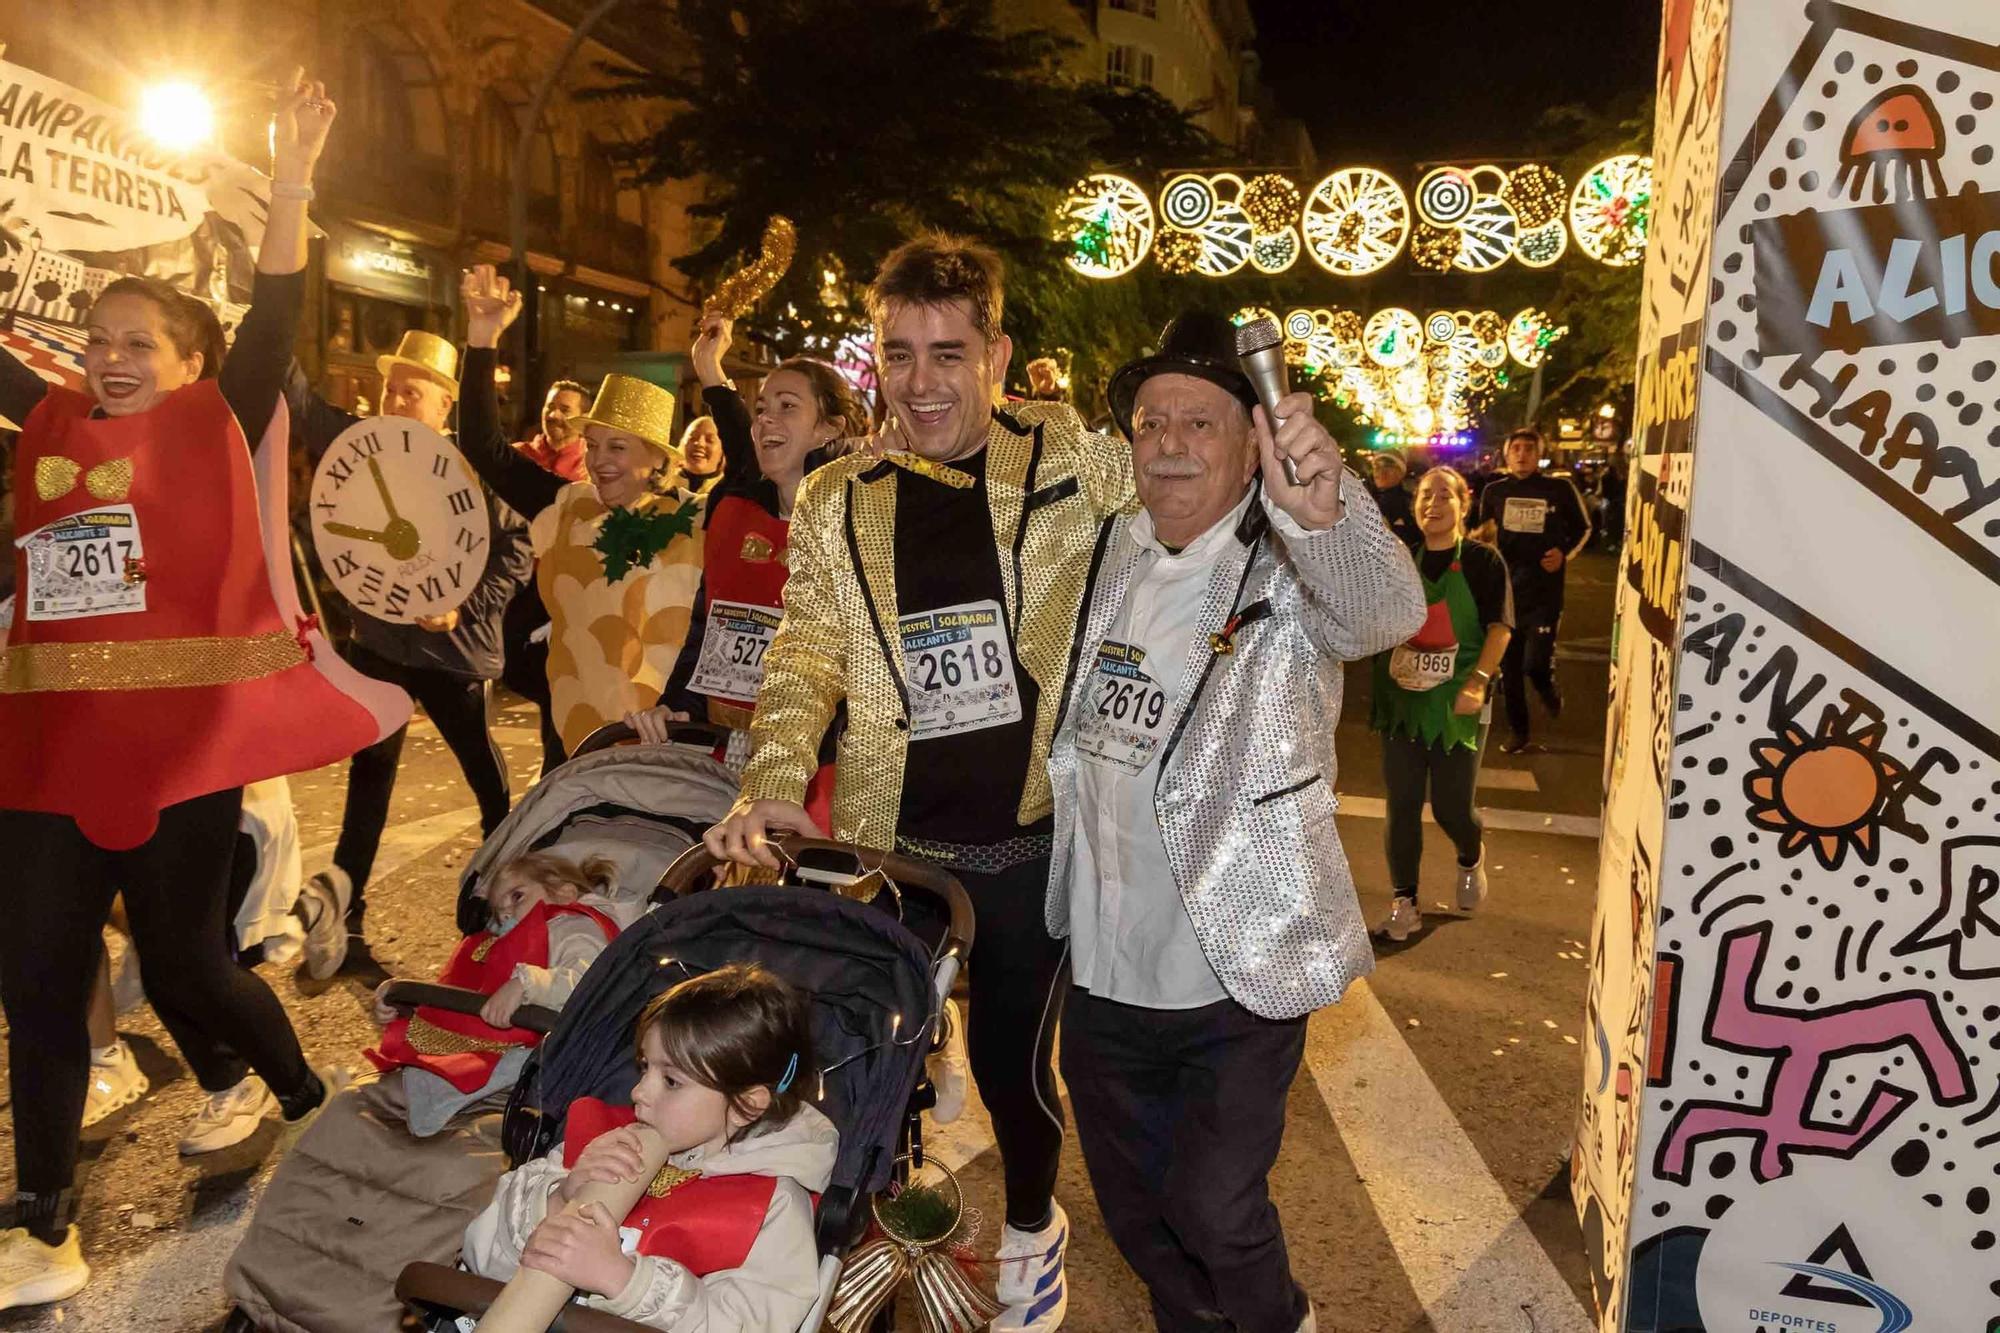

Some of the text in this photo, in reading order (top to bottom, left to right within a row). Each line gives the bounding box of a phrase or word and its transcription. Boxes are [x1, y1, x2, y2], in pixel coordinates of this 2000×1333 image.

[46, 148, 187, 222] TERRETA
[348, 432, 384, 464] XII
[326, 456, 354, 490] XI
[432, 454, 449, 480] II
[317, 493, 337, 518] X
[447, 488, 475, 515] III
[455, 527, 485, 554] IV
[66, 540, 133, 578] 2617
[332, 550, 361, 579] IX
[358, 565, 386, 607] VIII
[446, 561, 462, 589] V
[385, 582, 410, 618] VII
[417, 576, 446, 602] VI
[938, 613, 994, 628] SOLIDARIA
[906, 632, 954, 651] ALICANTE
[919, 639, 1003, 692] 2618
[1101, 660, 1138, 678] ALICANTE
[1414, 654, 1450, 674] 1969
[1097, 679, 1165, 730] 2619
[1749, 1308, 1837, 1333] DEPORTES
